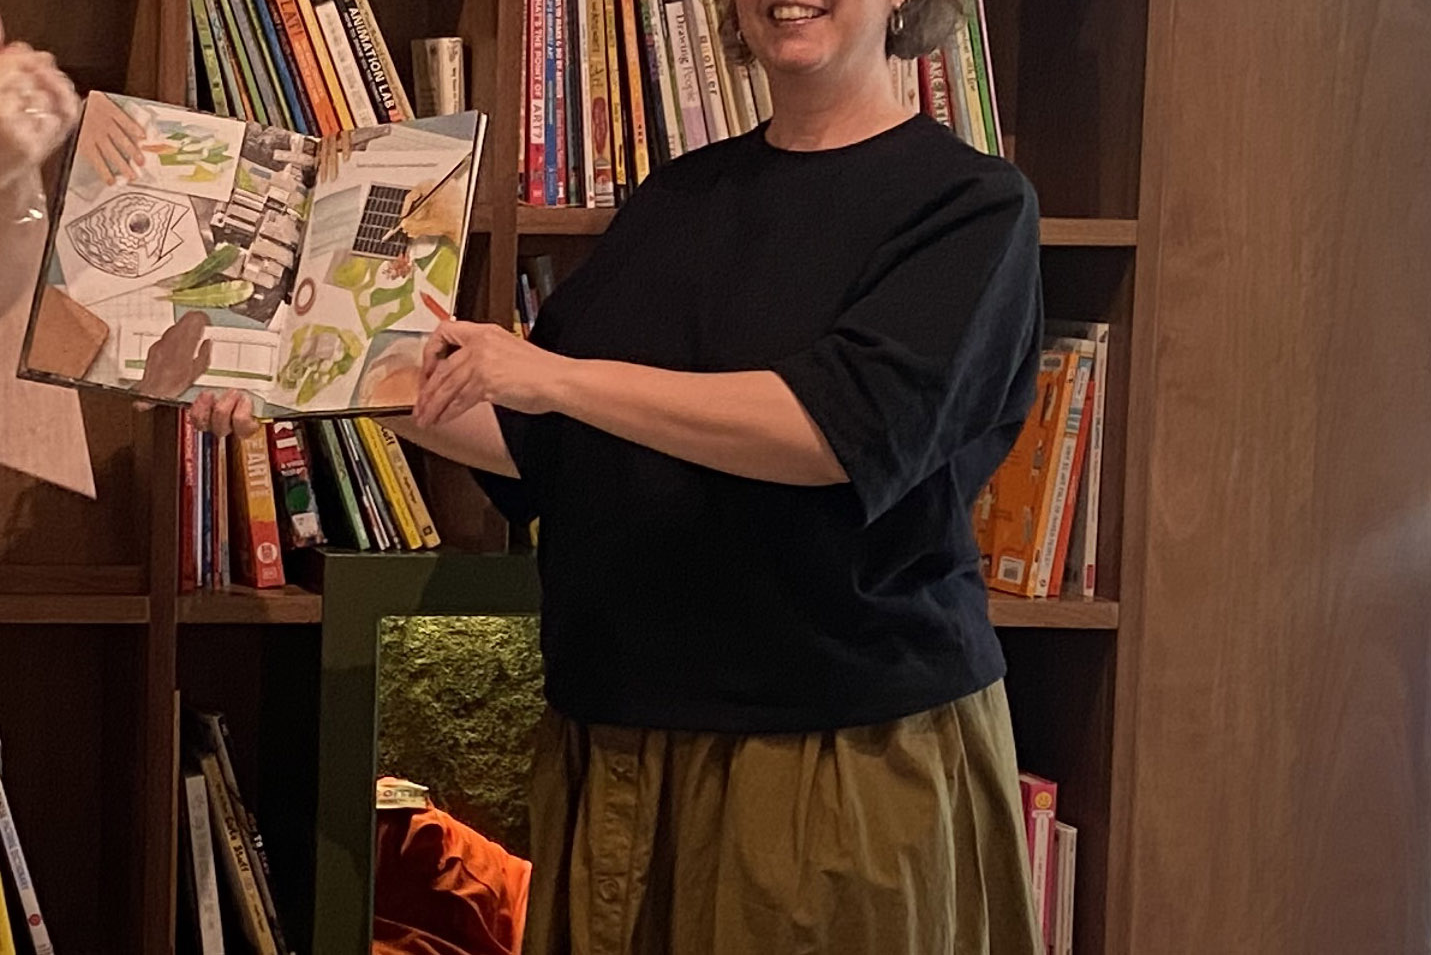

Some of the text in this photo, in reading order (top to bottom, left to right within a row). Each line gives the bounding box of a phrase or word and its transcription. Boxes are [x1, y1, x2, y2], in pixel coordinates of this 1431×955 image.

[533, 29, 543, 48] THE
[590, 12, 600, 53] Answers
[675, 14, 692, 65] Drawing
[348, 8, 394, 109] ANIMATION LAB
[533, 50, 543, 82] POINT
[533, 83, 543, 99] OF
[531, 102, 544, 140] ART?
[247, 453, 268, 492] ART
